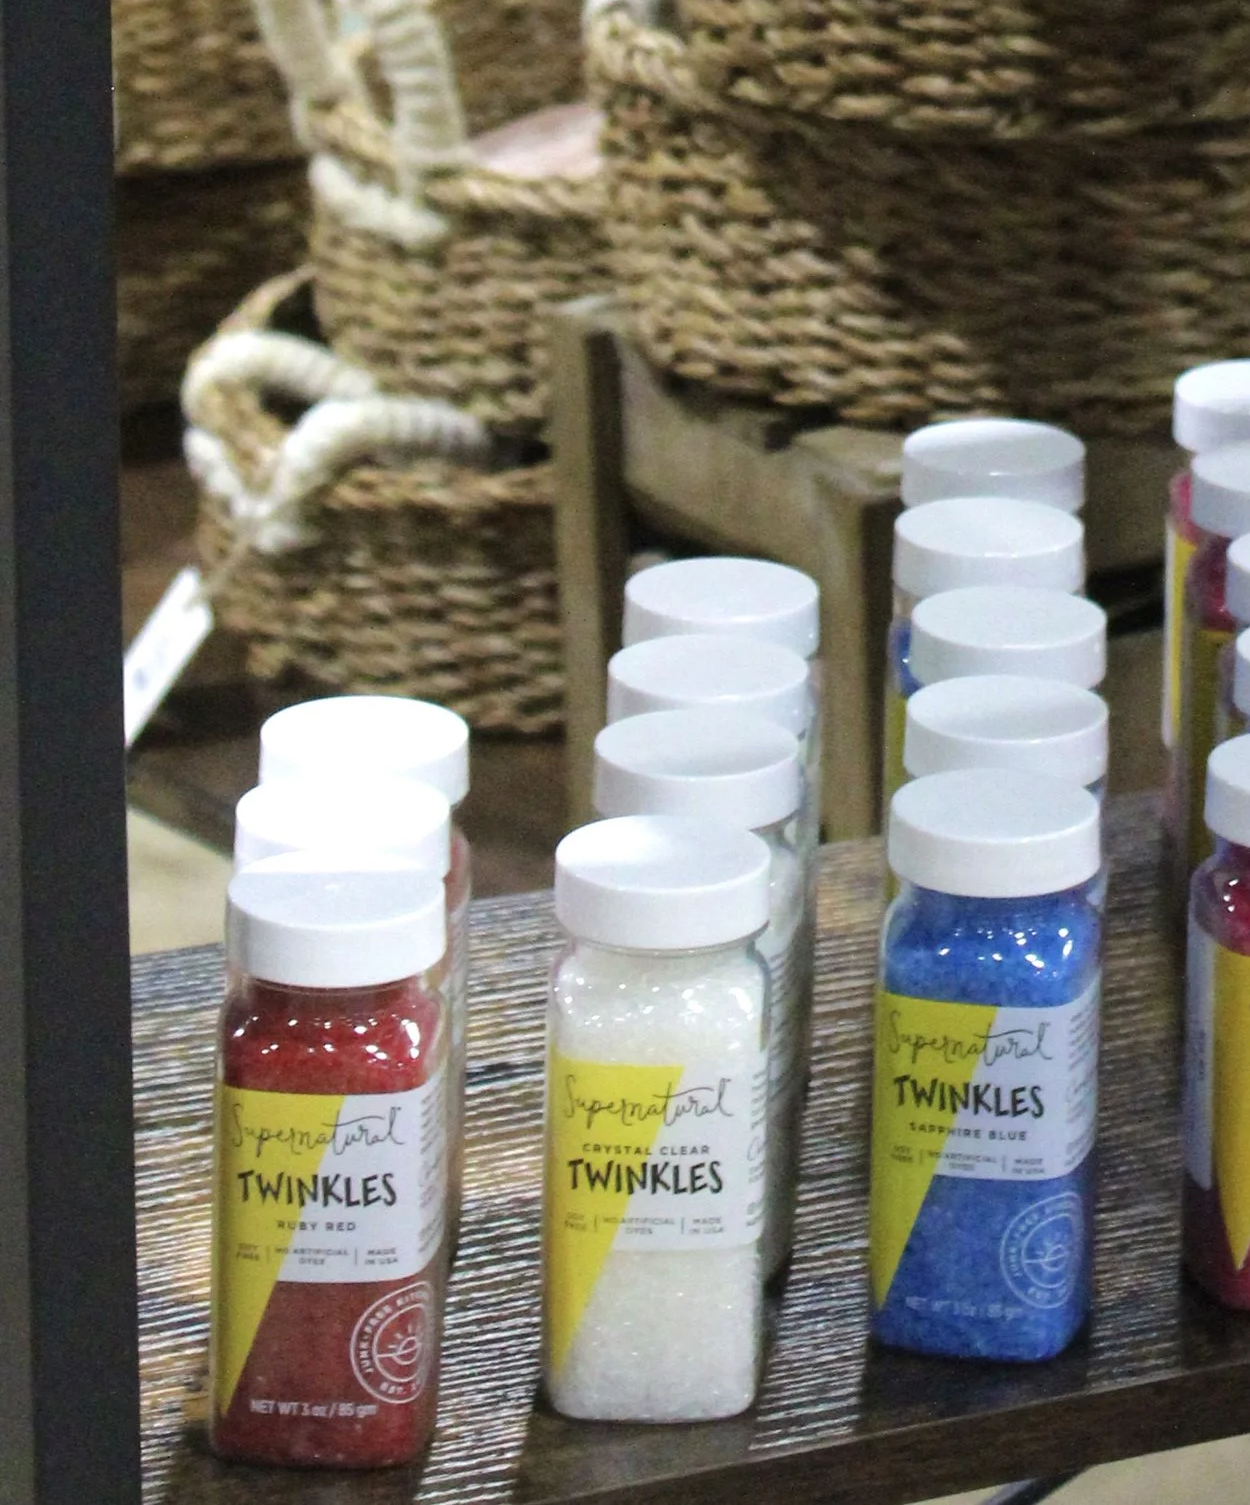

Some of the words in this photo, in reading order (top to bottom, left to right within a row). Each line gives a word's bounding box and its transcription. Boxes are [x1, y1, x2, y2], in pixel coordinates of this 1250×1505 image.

[889, 1010, 1053, 1066] Supernatural
[564, 1074, 734, 1130] Supernatural
[893, 1074, 1045, 1119] TWINKLES
[232, 1103, 405, 1158] Supernatural
[582, 1143, 652, 1155] CRYSTAL
[659, 1144, 710, 1155] CLEAR
[909, 1121, 981, 1140] SAPPHIRE
[988, 1131, 1028, 1141] BLUE
[237, 1170, 398, 1207] TWINKLES
[567, 1158, 723, 1195] TWINKLES
[276, 1220, 318, 1231] RUBY
[325, 1221, 357, 1231] RED
[251, 1399, 276, 1415] NET
[278, 1401, 298, 1416] WT
